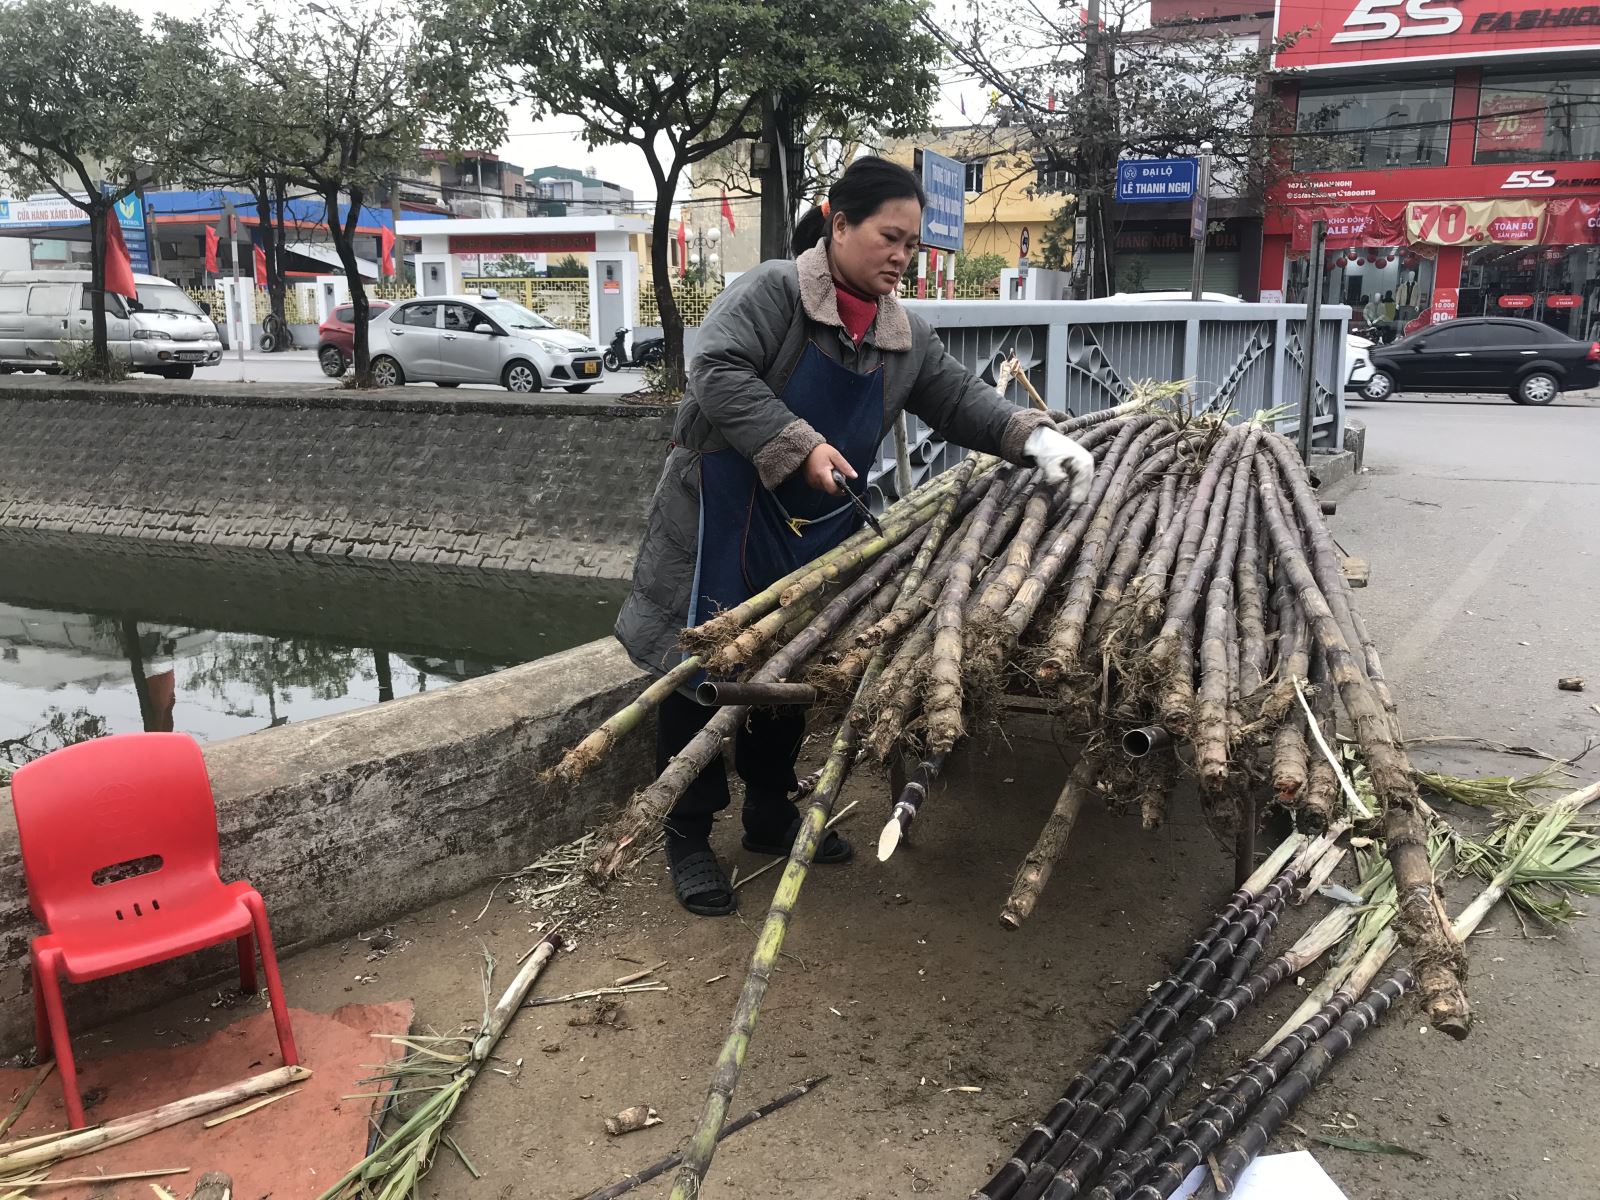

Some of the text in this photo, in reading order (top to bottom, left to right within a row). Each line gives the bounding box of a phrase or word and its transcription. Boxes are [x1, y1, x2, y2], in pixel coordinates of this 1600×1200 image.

[1330, 0, 1464, 43] 5S
[1142, 165, 1173, 178] ĐẠI LỘ
[1500, 169, 1556, 189] 5S
[1122, 181, 1191, 195] LÊ THANH NGHỊ
[31, 207, 49, 220] HÀNG
[1328, 217, 1346, 225] KHO
[1494, 219, 1534, 232] TOÀN BỘ
[1327, 226, 1349, 235] ALE
